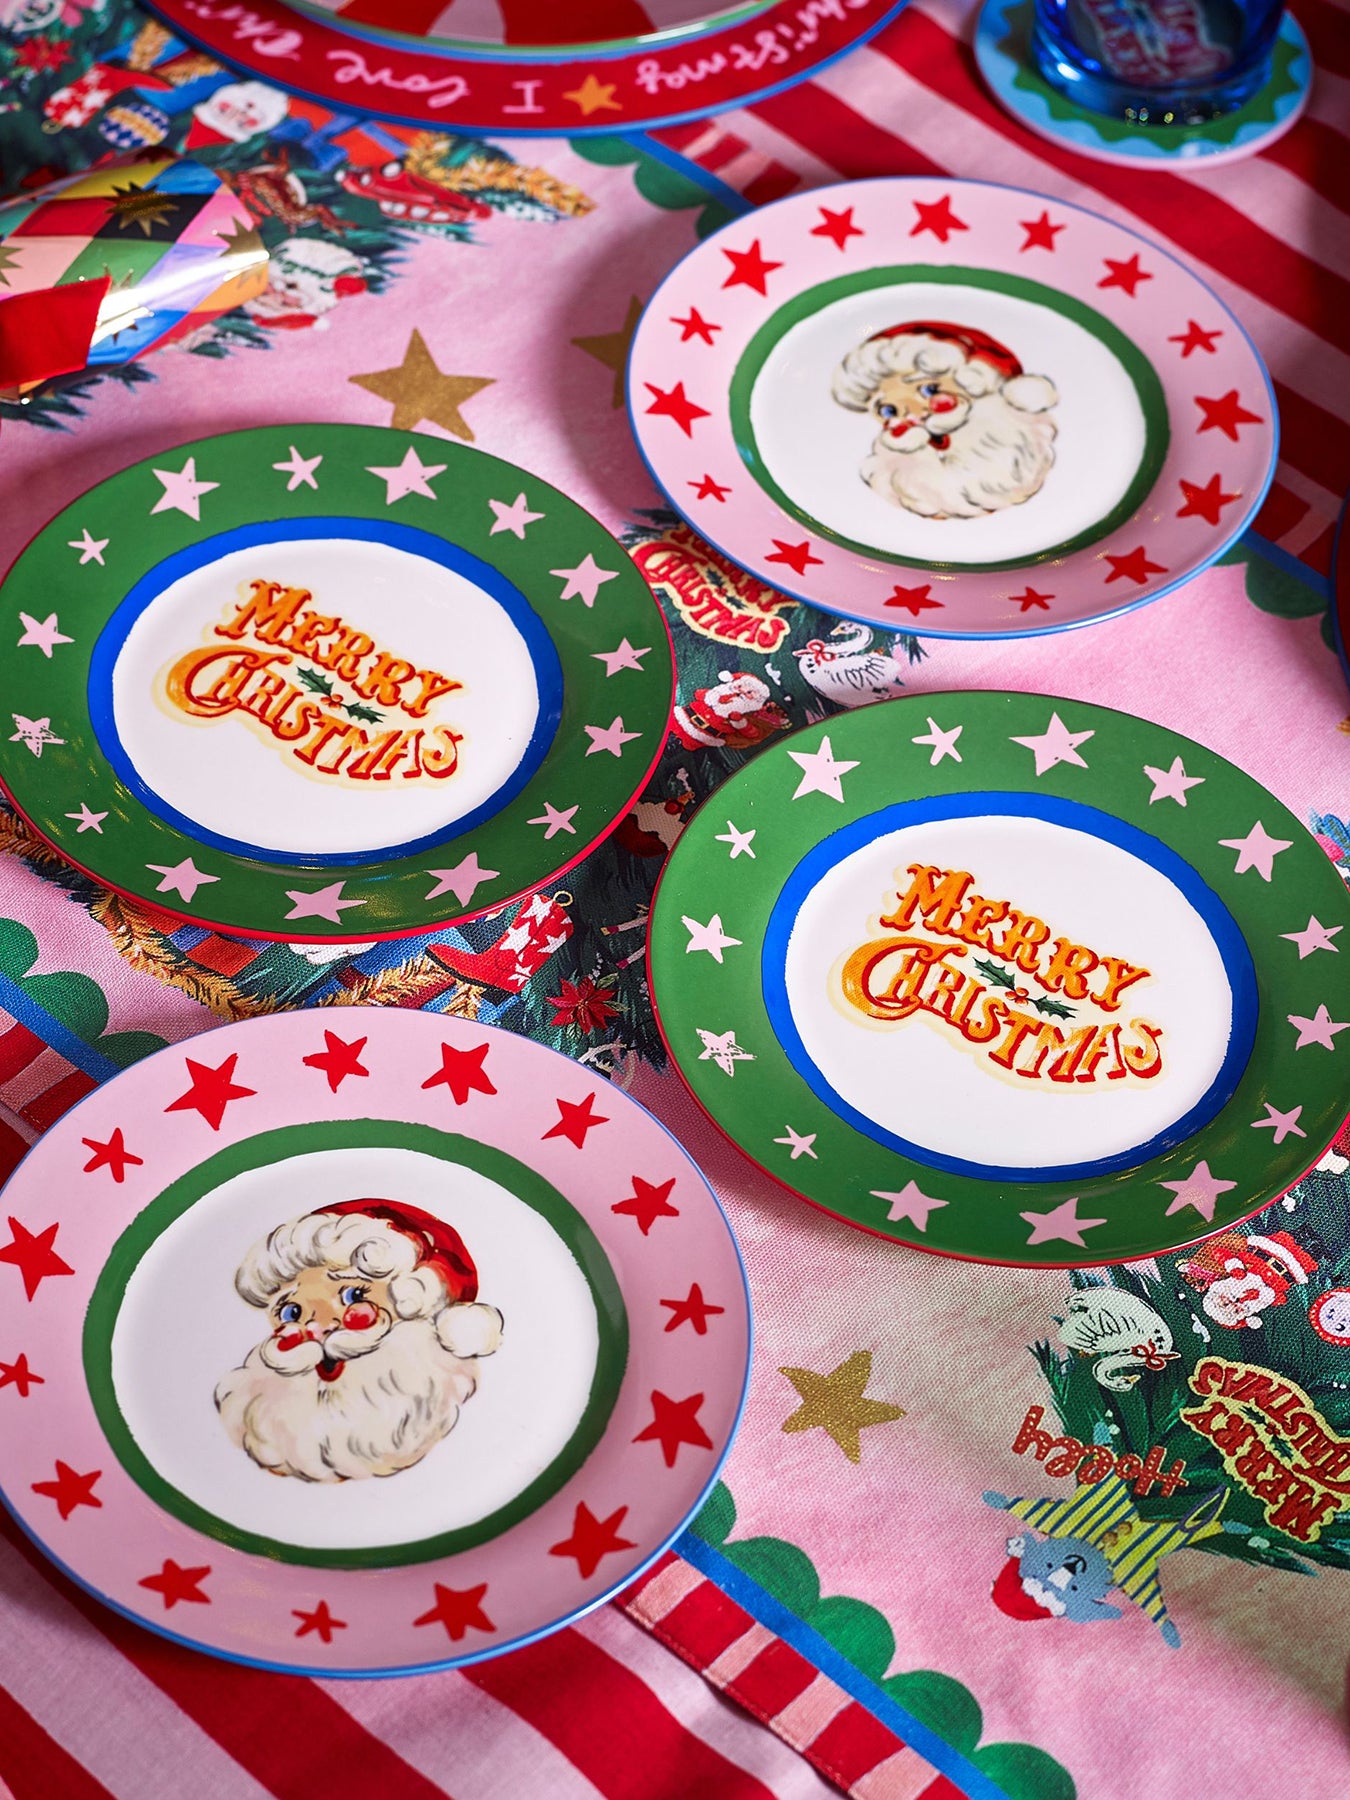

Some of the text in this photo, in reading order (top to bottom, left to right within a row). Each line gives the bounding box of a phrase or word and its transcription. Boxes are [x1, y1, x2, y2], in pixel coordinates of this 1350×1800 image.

[326, 51, 470, 108] love
[501, 80, 543, 114] I
[166, 644, 464, 780] CHRISTMAS
[214, 579, 463, 719] MERRY
[879, 863, 1151, 1012] MERRY
[841, 936, 1163, 1083] CHRISTMAS
[1011, 1404, 1189, 1497] Holly
[1184, 1401, 1342, 1542] MERRY
